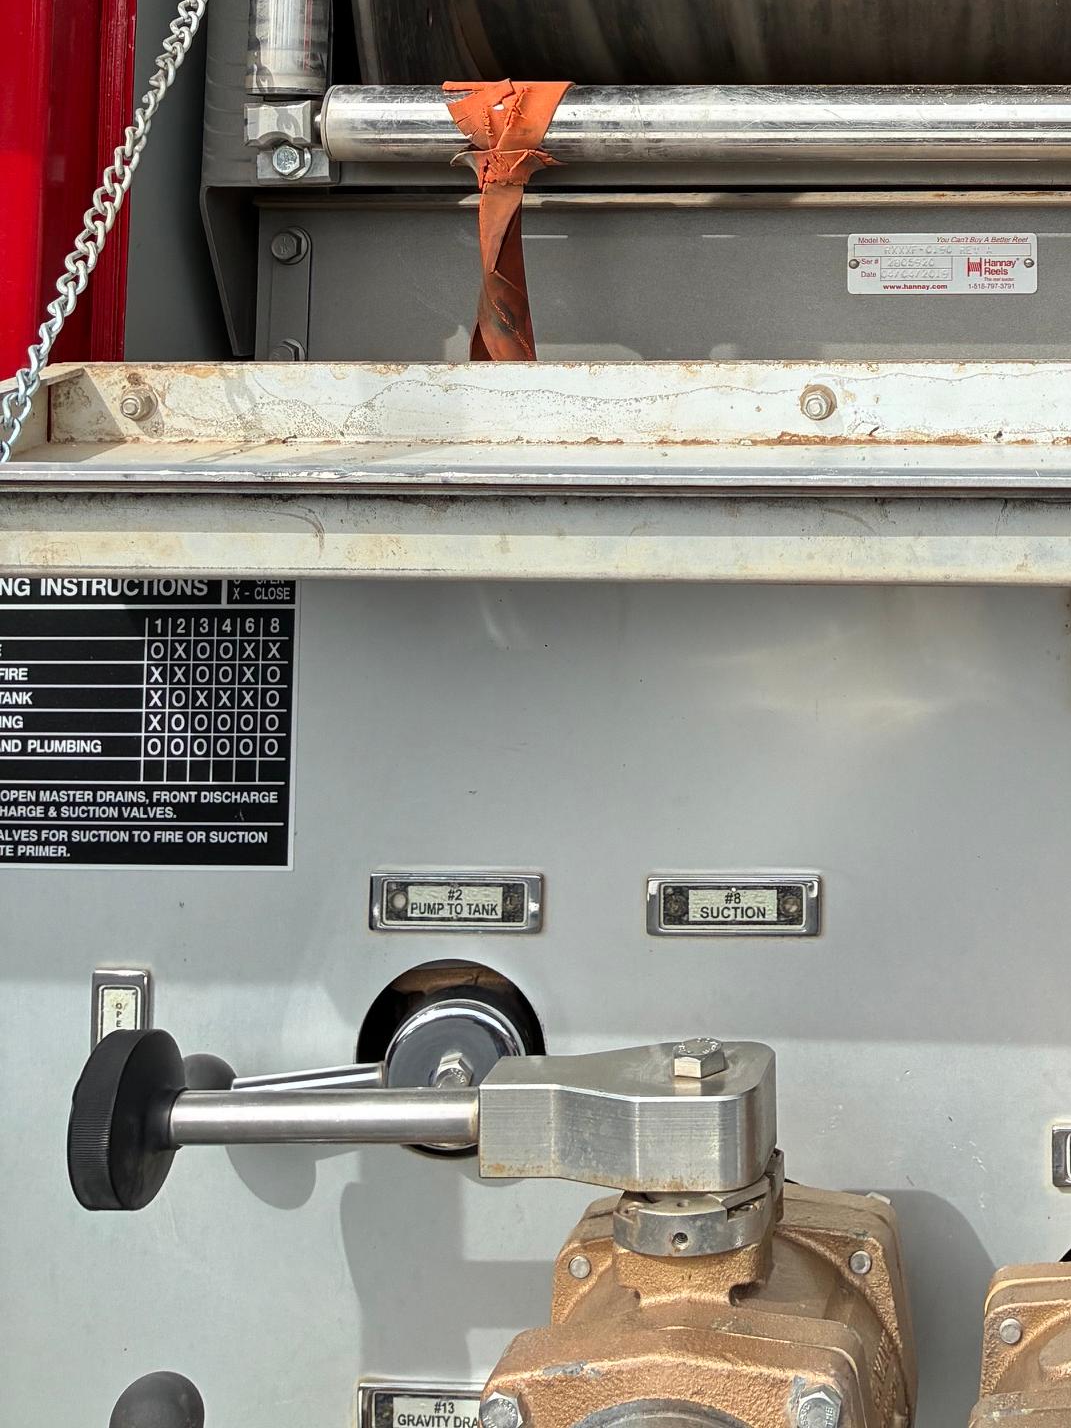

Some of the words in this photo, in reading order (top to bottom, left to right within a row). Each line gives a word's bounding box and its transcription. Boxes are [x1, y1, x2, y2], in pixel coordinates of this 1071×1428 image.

[984, 258, 1016, 268] Hannay
[984, 267, 1008, 275] Reels
[40, 578, 208, 596] INSTRUCTIONS
[233, 588, 240, 600] X
[254, 587, 291, 600] CLOSE
[155, 619, 161, 633] 1
[177, 619, 185, 633] 2
[200, 618, 208, 633] 3
[222, 619, 231, 633] 4
[246, 618, 254, 632] 6
[271, 618, 279, 632] 8
[174, 643, 186, 658] X
[243, 643, 255, 658] X
[268, 643, 280, 658] X
[150, 666, 163, 682] X
[173, 667, 185, 682] X
[242, 667, 255, 682] X
[149, 690, 162, 706] X
[195, 691, 208, 706] X
[218, 690, 231, 706] X
[241, 691, 254, 706] X
[148, 714, 161, 731] X
[28, 739, 102, 753] PLUMBING
[0, 790, 36, 802] OPEN
[39, 790, 93, 802] MASTER
[96, 791, 150, 804] DRAINS,
[153, 791, 198, 803] FRONT
[200, 792, 279, 804] DISCHARGE
[48, 806, 58, 818] &
[60, 806, 119, 818] SUCTION
[121, 806, 177, 819] VALVES.
[41, 830, 68, 842] FOR
[71, 830, 130, 842] SUCTION
[132, 830, 151, 843] TO
[153, 831, 183, 843] FIRE
[186, 831, 206, 843] OR
[209, 831, 268, 844] SUCTION
[17, 845, 71, 857] PRIMER.
[447, 889, 463, 901] #2
[725, 892, 741, 904] #8
[410, 902, 445, 915] PUMP
[447, 903, 463, 915] TO
[466, 903, 498, 916] TANK
[700, 906, 766, 919] SUCTION
[434, 1401, 455, 1414] #13
[397, 1414, 451, 1428] GRAVITY
[453, 1416, 480, 1428] DRA
